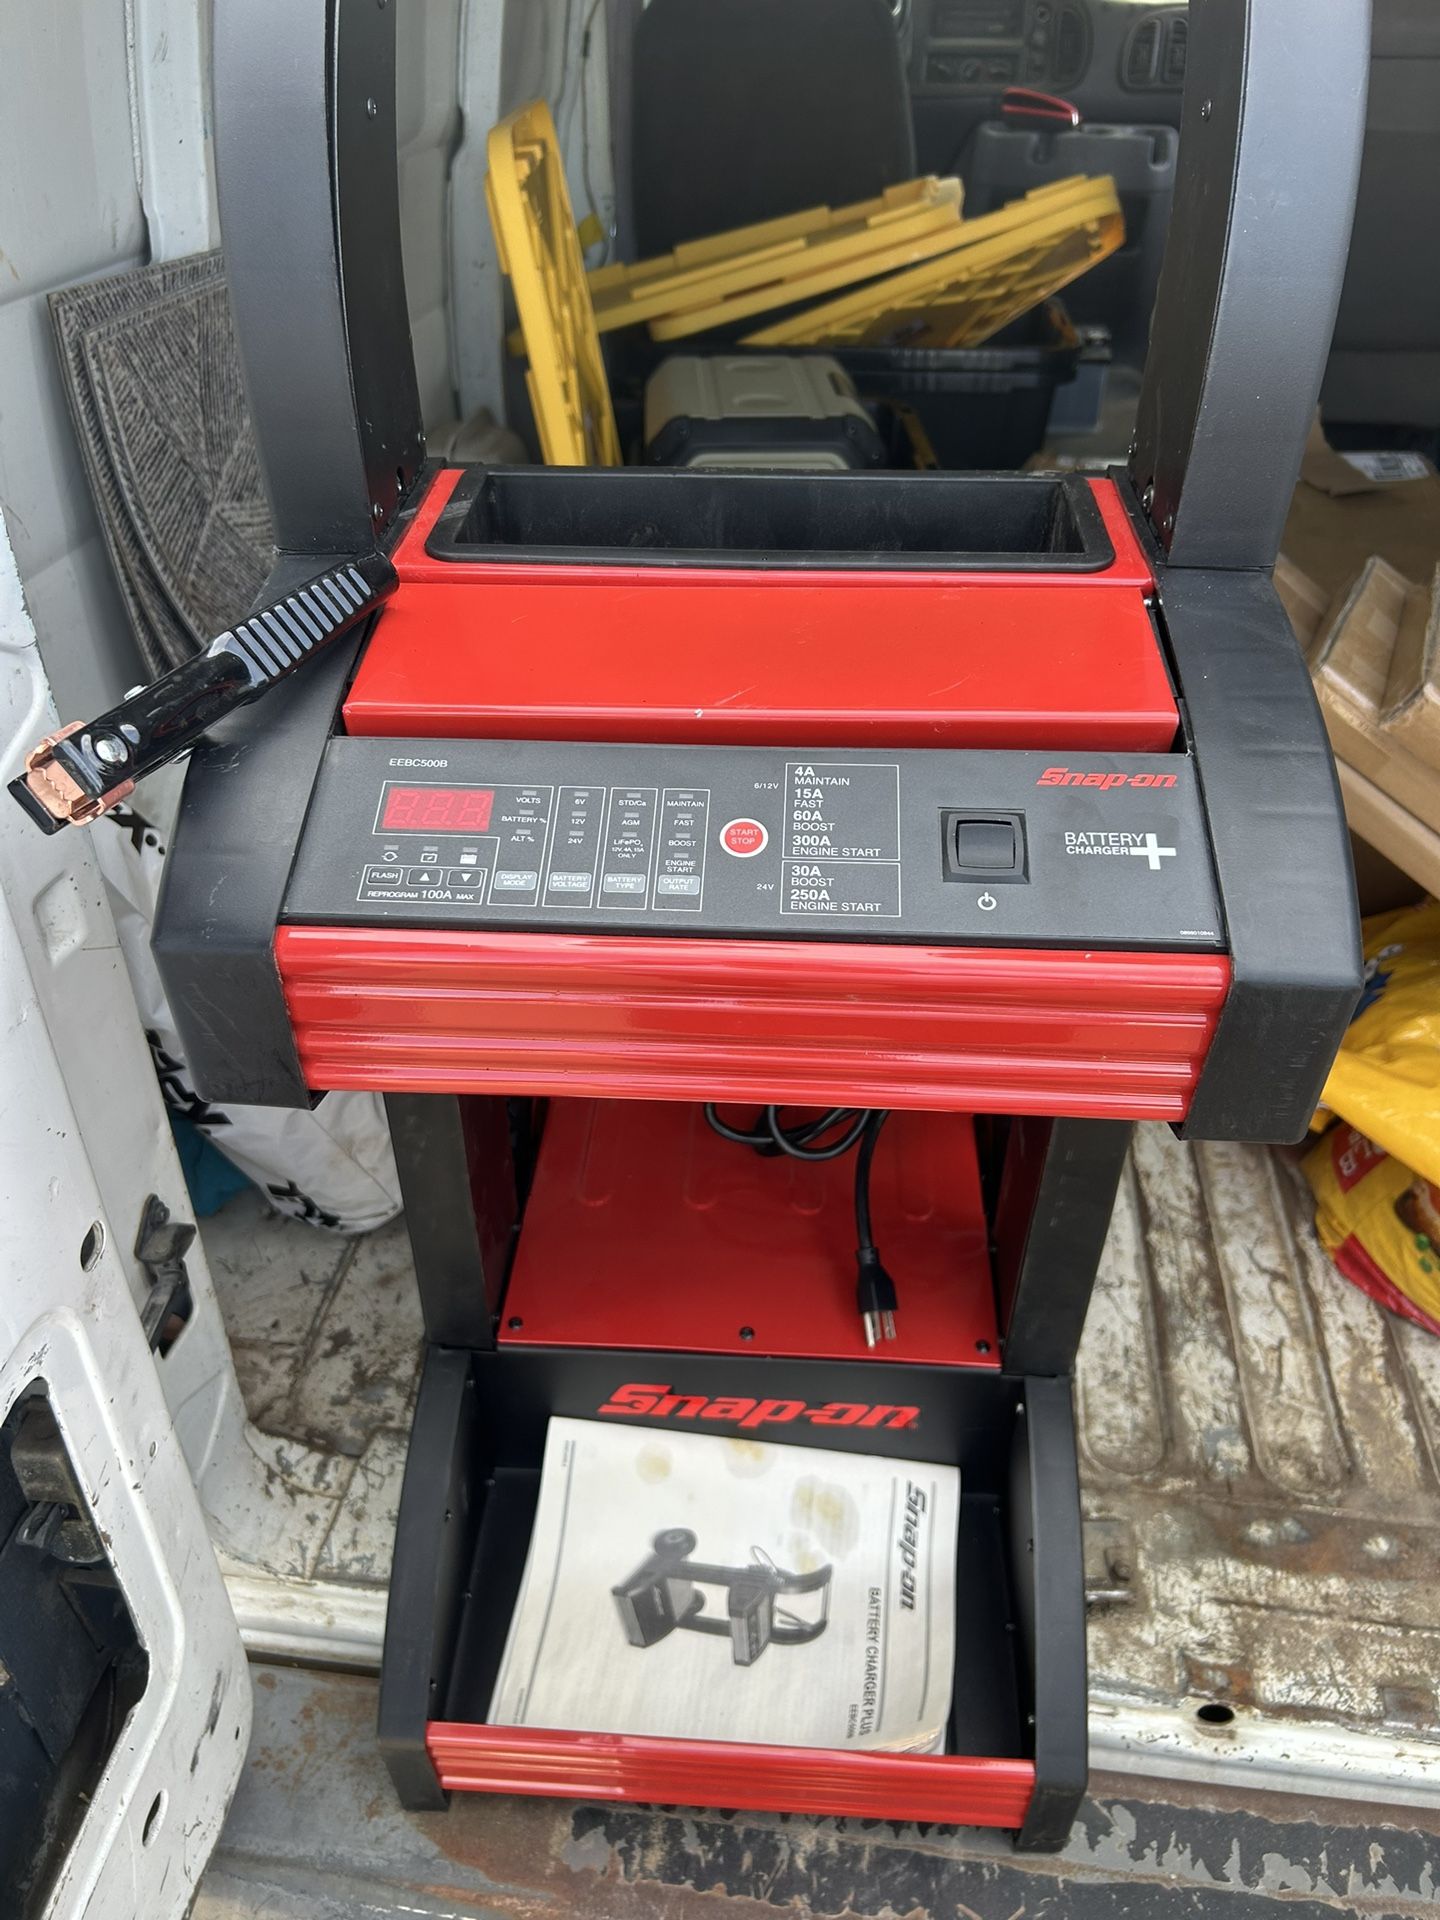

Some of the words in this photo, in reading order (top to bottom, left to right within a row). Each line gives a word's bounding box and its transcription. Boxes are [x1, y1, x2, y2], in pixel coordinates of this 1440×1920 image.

[389, 758, 448, 768] EEBC500B
[794, 766, 815, 777] 4A
[794, 777, 850, 786] MAINTAIN
[1036, 767, 1178, 791] Snap-on
[754, 782, 779, 790] 6/12V
[794, 788, 824, 799] 15A
[618, 799, 647, 807] STD/Ca
[794, 799, 824, 808] FAST
[501, 815, 538, 823] BATTERY
[793, 810, 823, 821] 60A
[793, 822, 836, 831] BOOST
[729, 828, 760, 836] START
[730, 837, 756, 845] STOP
[792, 835, 831, 847] 300A
[1065, 832, 1144, 846] BATTERY
[792, 847, 838, 857] ENGINE
[841, 847, 881, 857] START
[1066, 846, 1129, 856] CHARGER
[791, 865, 822, 877] 30A
[791, 877, 835, 886] BOOST
[756, 883, 775, 891] 24V
[367, 891, 418, 899] REPROGRAM
[421, 890, 452, 900] 100A
[790, 889, 830, 901] 250A
[790, 901, 838, 911] ENGINE
[841, 902, 882, 912] START
[597, 1383, 921, 1429] Snap-on
[897, 1479, 928, 1611] Snap-on
[867, 1587, 882, 1644] BATTERY
[863, 1646, 880, 1705] CHARGER
[858, 1707, 875, 1737] PLUS
